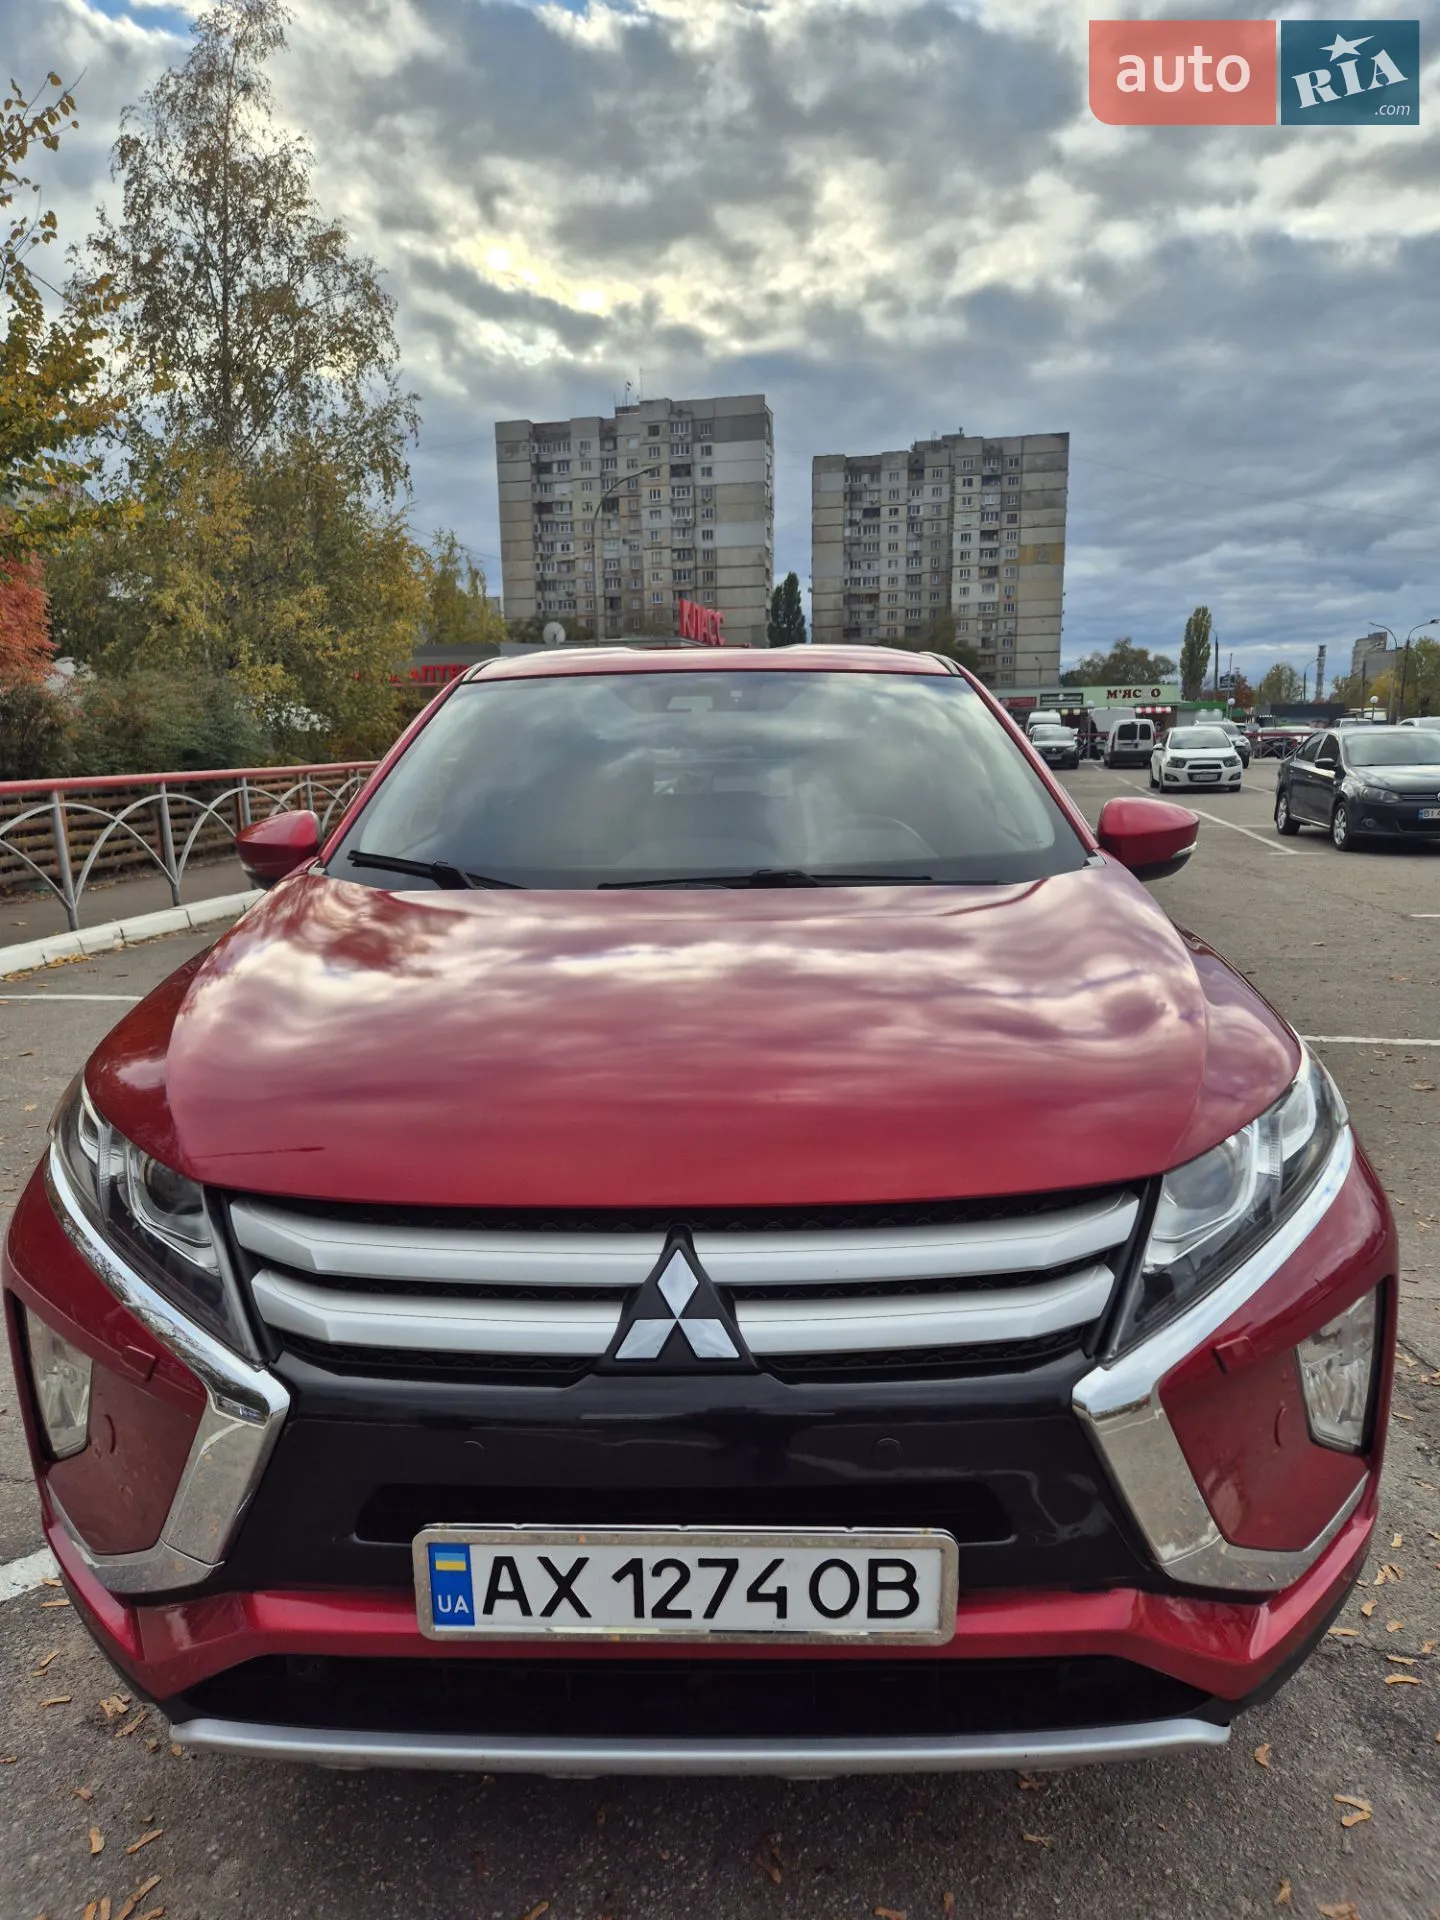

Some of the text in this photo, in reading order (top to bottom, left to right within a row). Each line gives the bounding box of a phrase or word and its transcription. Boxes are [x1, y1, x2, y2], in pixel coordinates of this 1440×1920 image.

[437, 1593, 470, 1614] UA
[482, 1555, 920, 1619] AX 1274 OB
